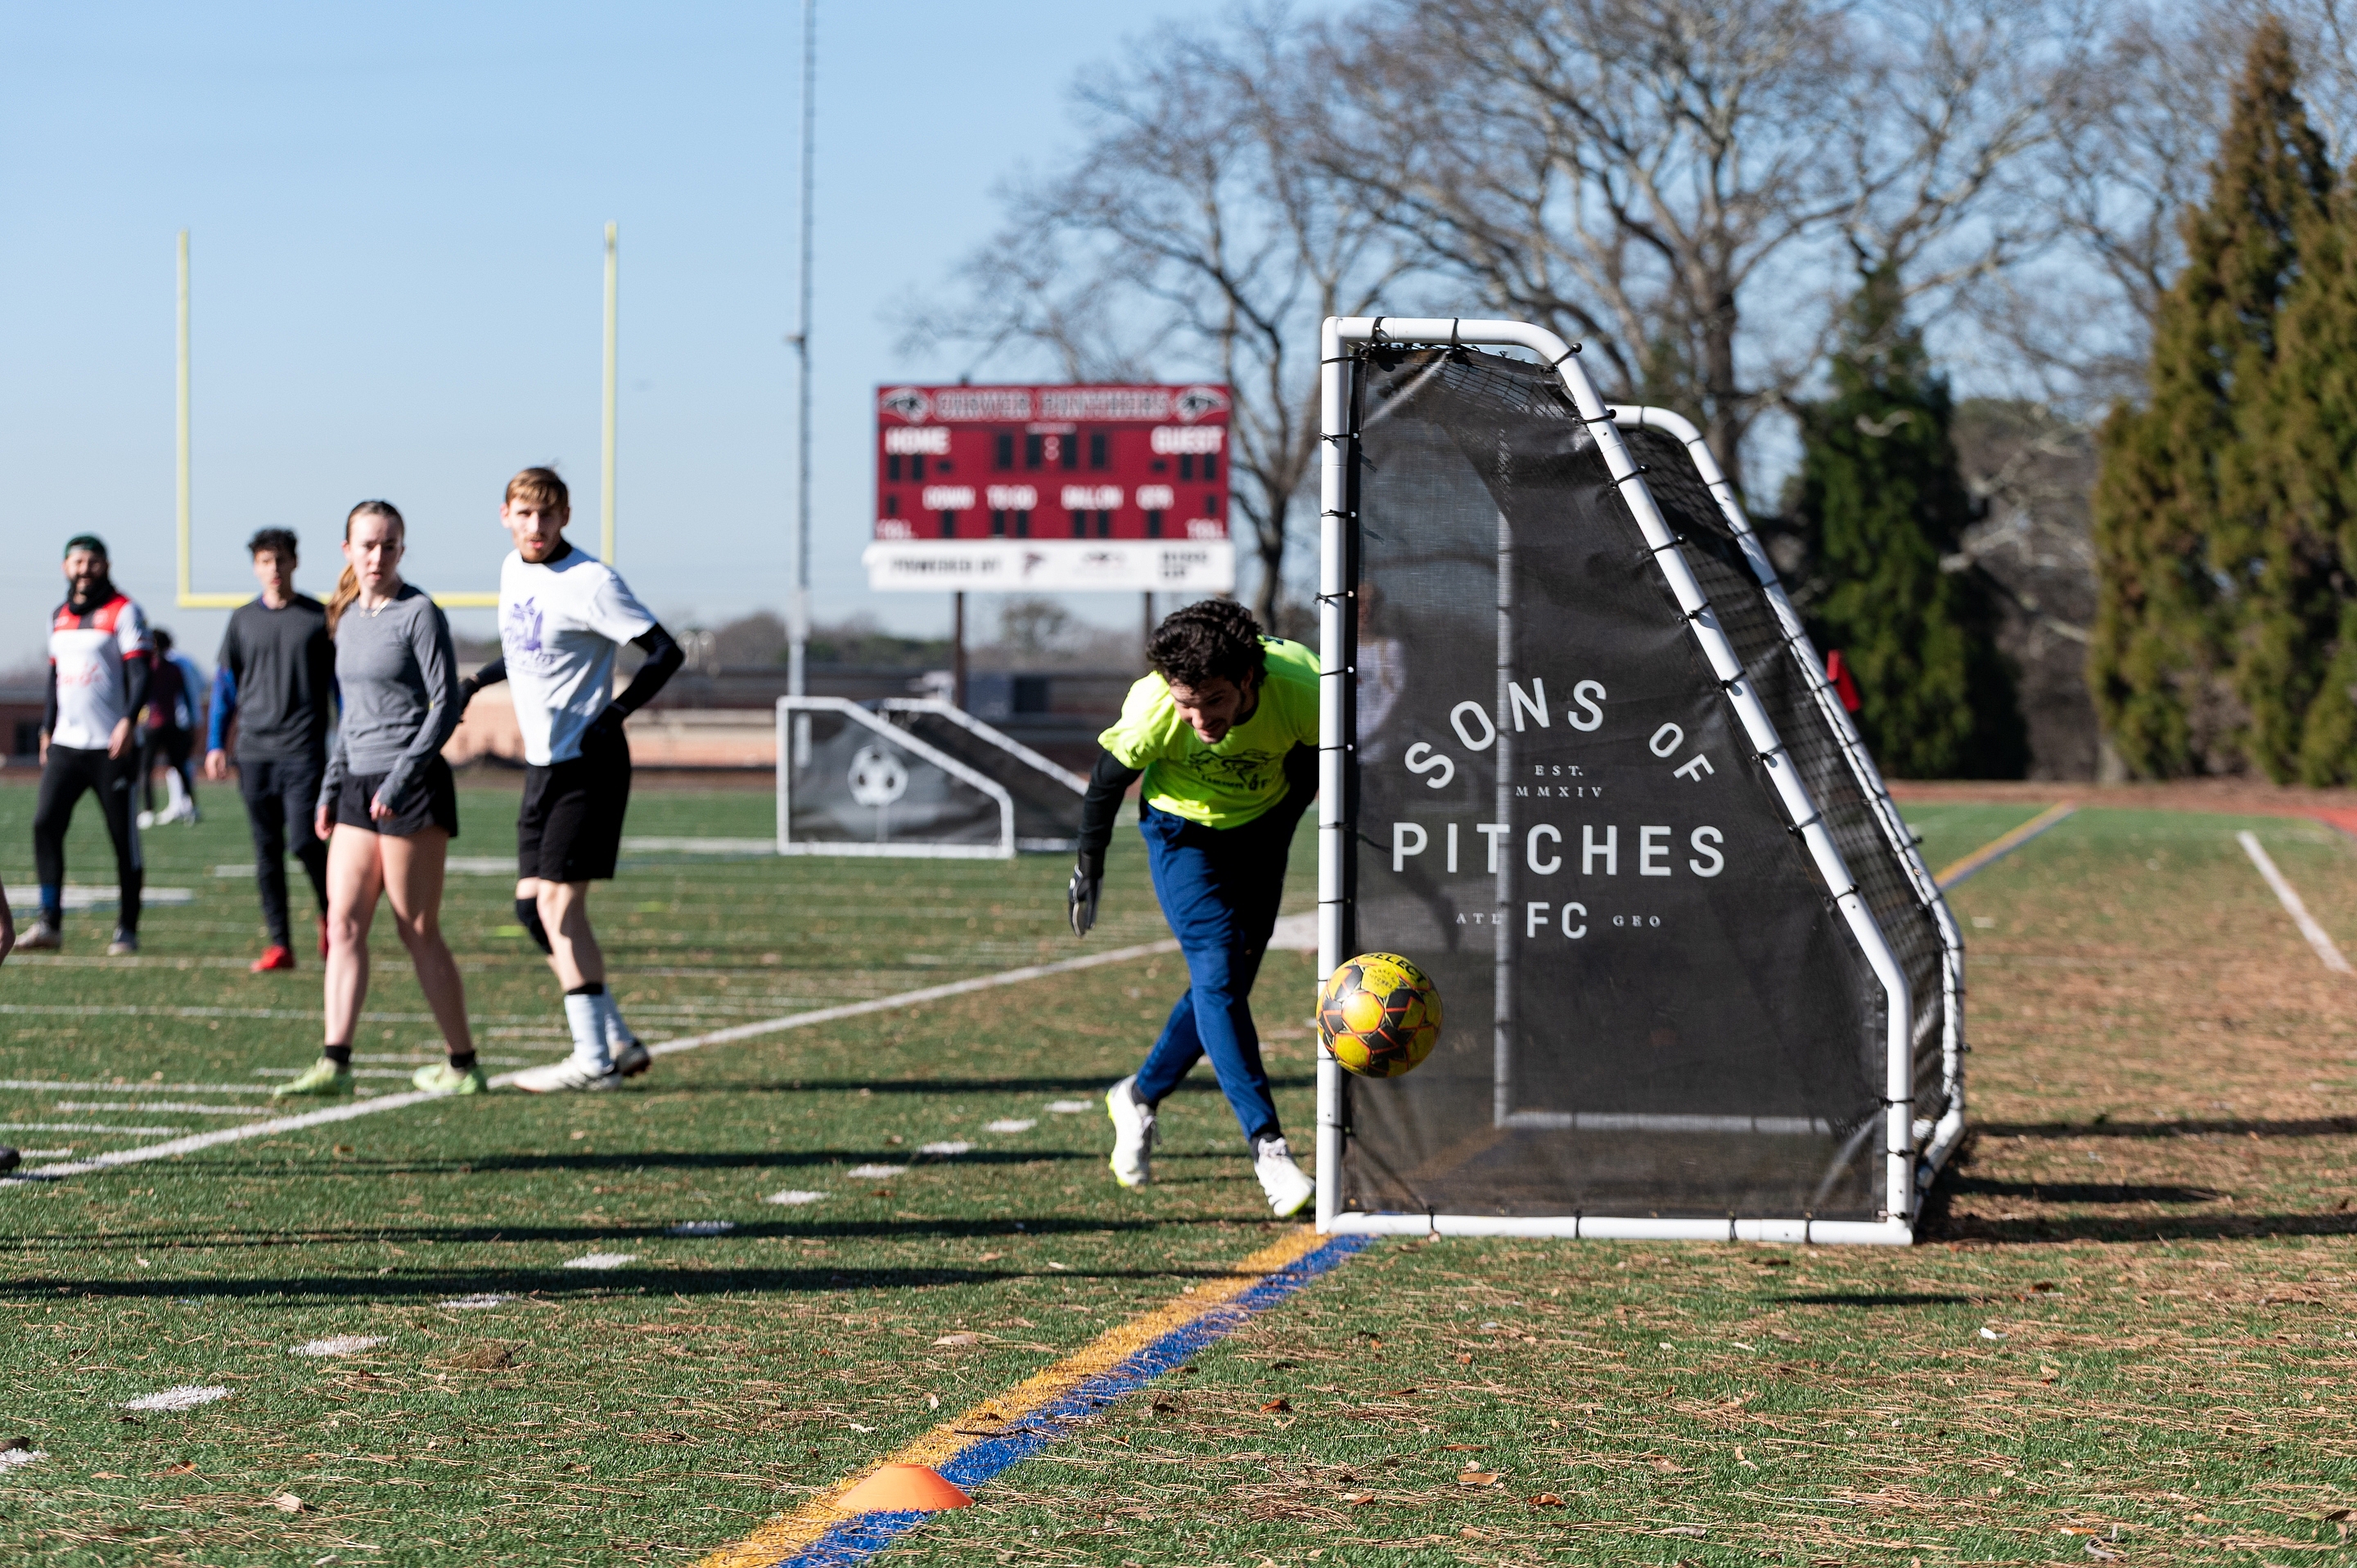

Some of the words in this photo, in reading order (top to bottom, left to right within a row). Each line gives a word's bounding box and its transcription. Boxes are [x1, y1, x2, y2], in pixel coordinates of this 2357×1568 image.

[1404, 678, 1607, 789] SONS
[1648, 722, 1715, 782] OF
[1535, 764, 1584, 777] EST.
[1516, 786, 1602, 798] MMXIV
[1393, 822, 1724, 877] PITCHES
[1456, 912, 1502, 925] ATL
[1527, 902, 1588, 939] FC
[1363, 953, 1426, 983] SELECT
